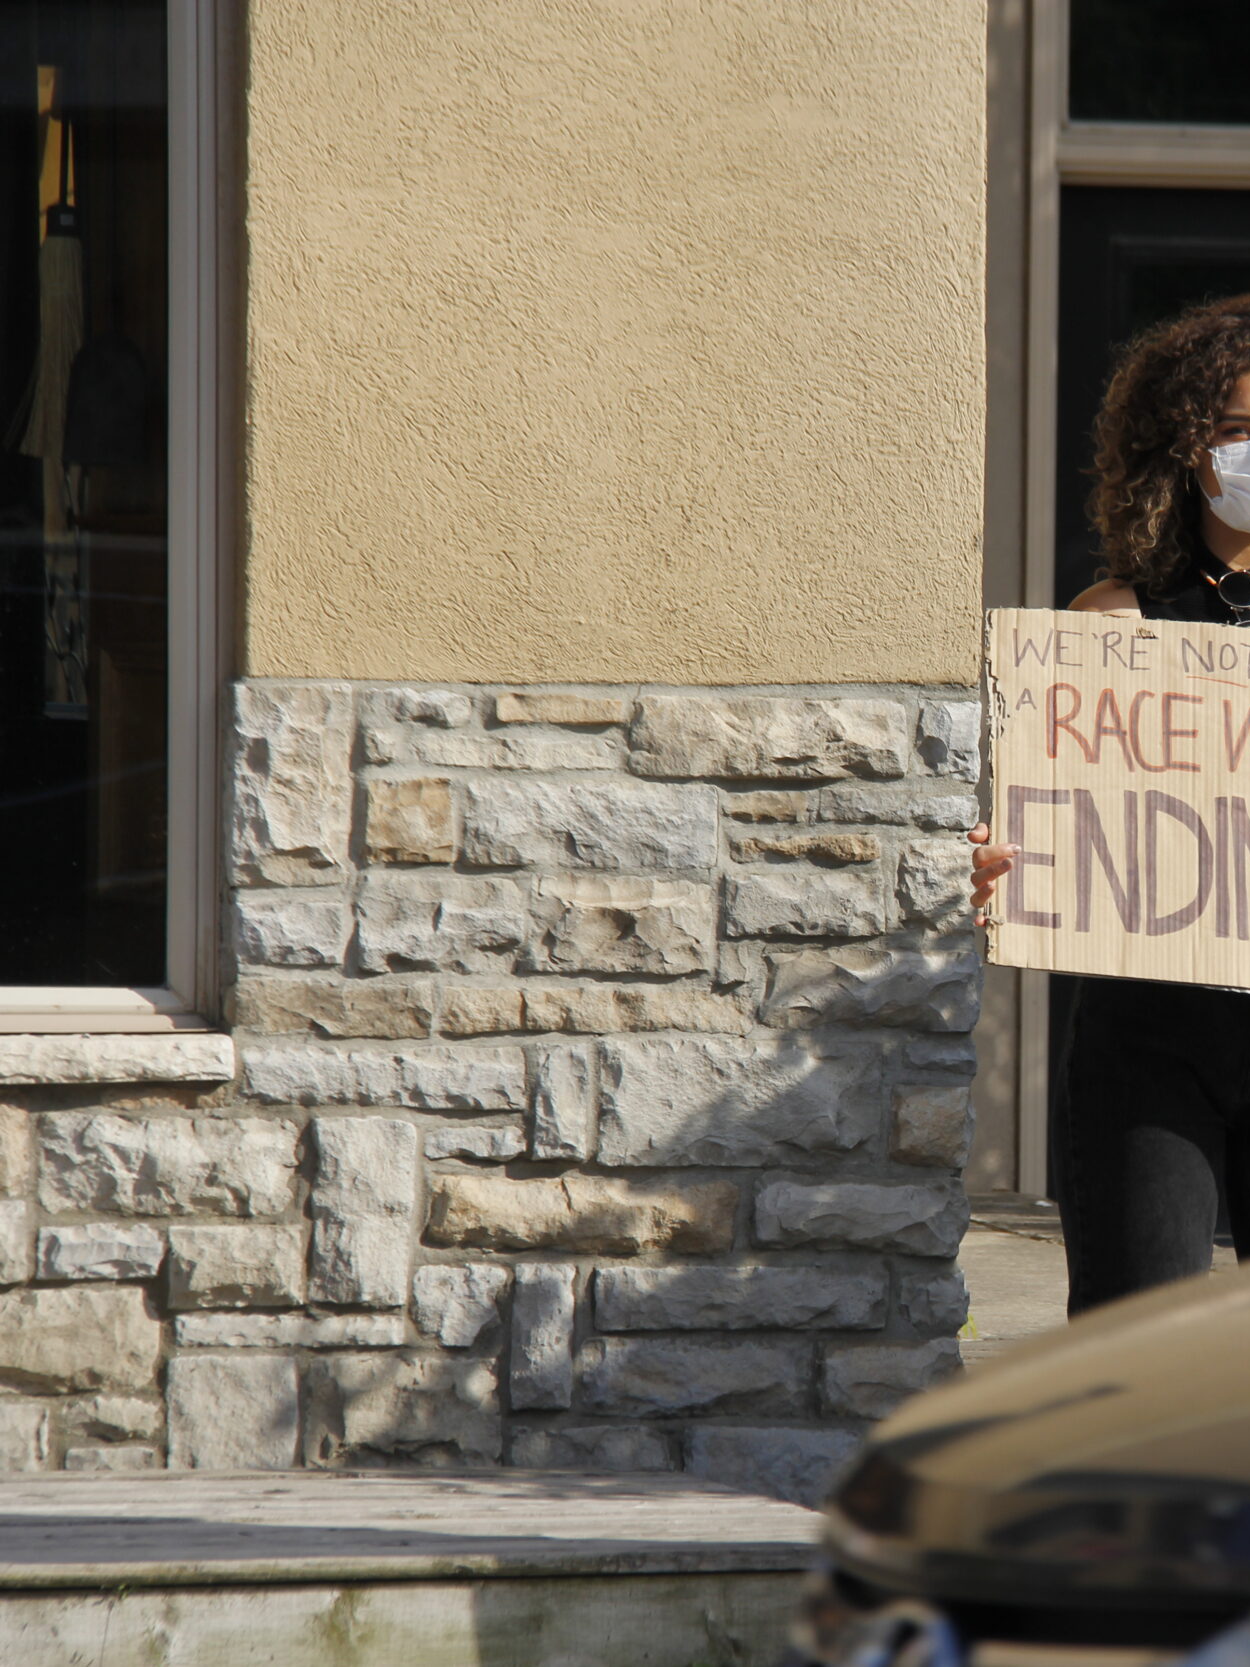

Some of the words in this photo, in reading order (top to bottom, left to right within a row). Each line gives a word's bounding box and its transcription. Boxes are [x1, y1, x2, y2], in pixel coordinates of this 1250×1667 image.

[1012, 628, 1159, 671] WE'RE
[1015, 688, 1037, 711] A
[1045, 682, 1203, 773] RACE
